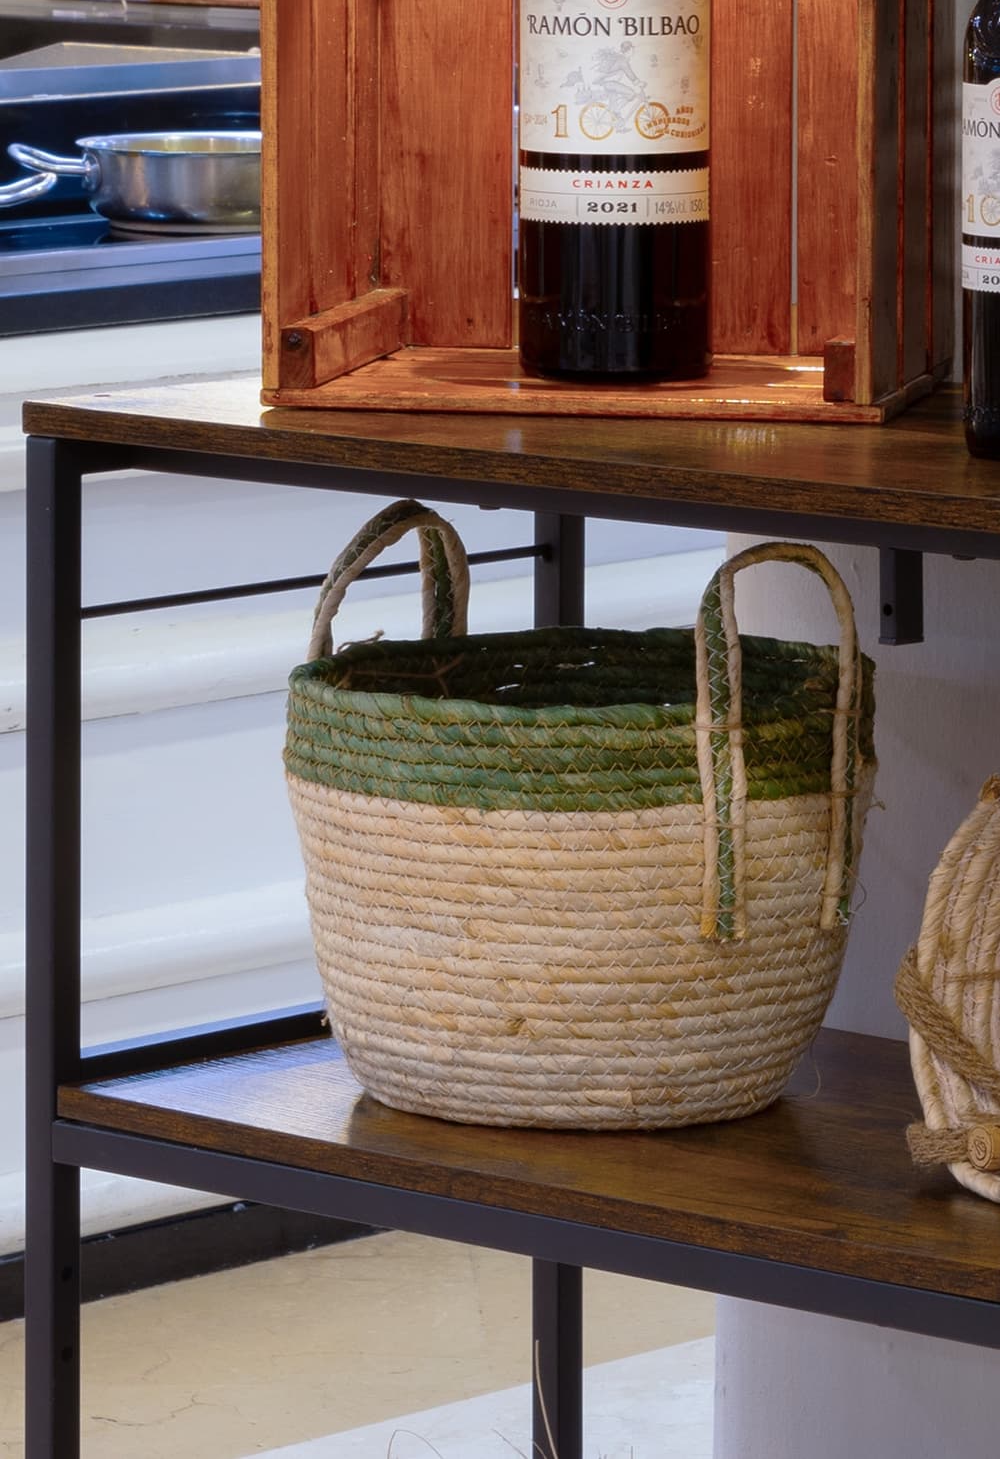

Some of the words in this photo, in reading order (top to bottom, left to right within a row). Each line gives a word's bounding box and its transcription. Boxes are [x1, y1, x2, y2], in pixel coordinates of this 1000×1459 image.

[527, 13, 611, 36] RAMÓN
[618, 14, 700, 36] BILBAO
[572, 179, 654, 189] CRIANZA
[529, 198, 558, 208] RIOJA
[587, 202, 638, 213] 2021
